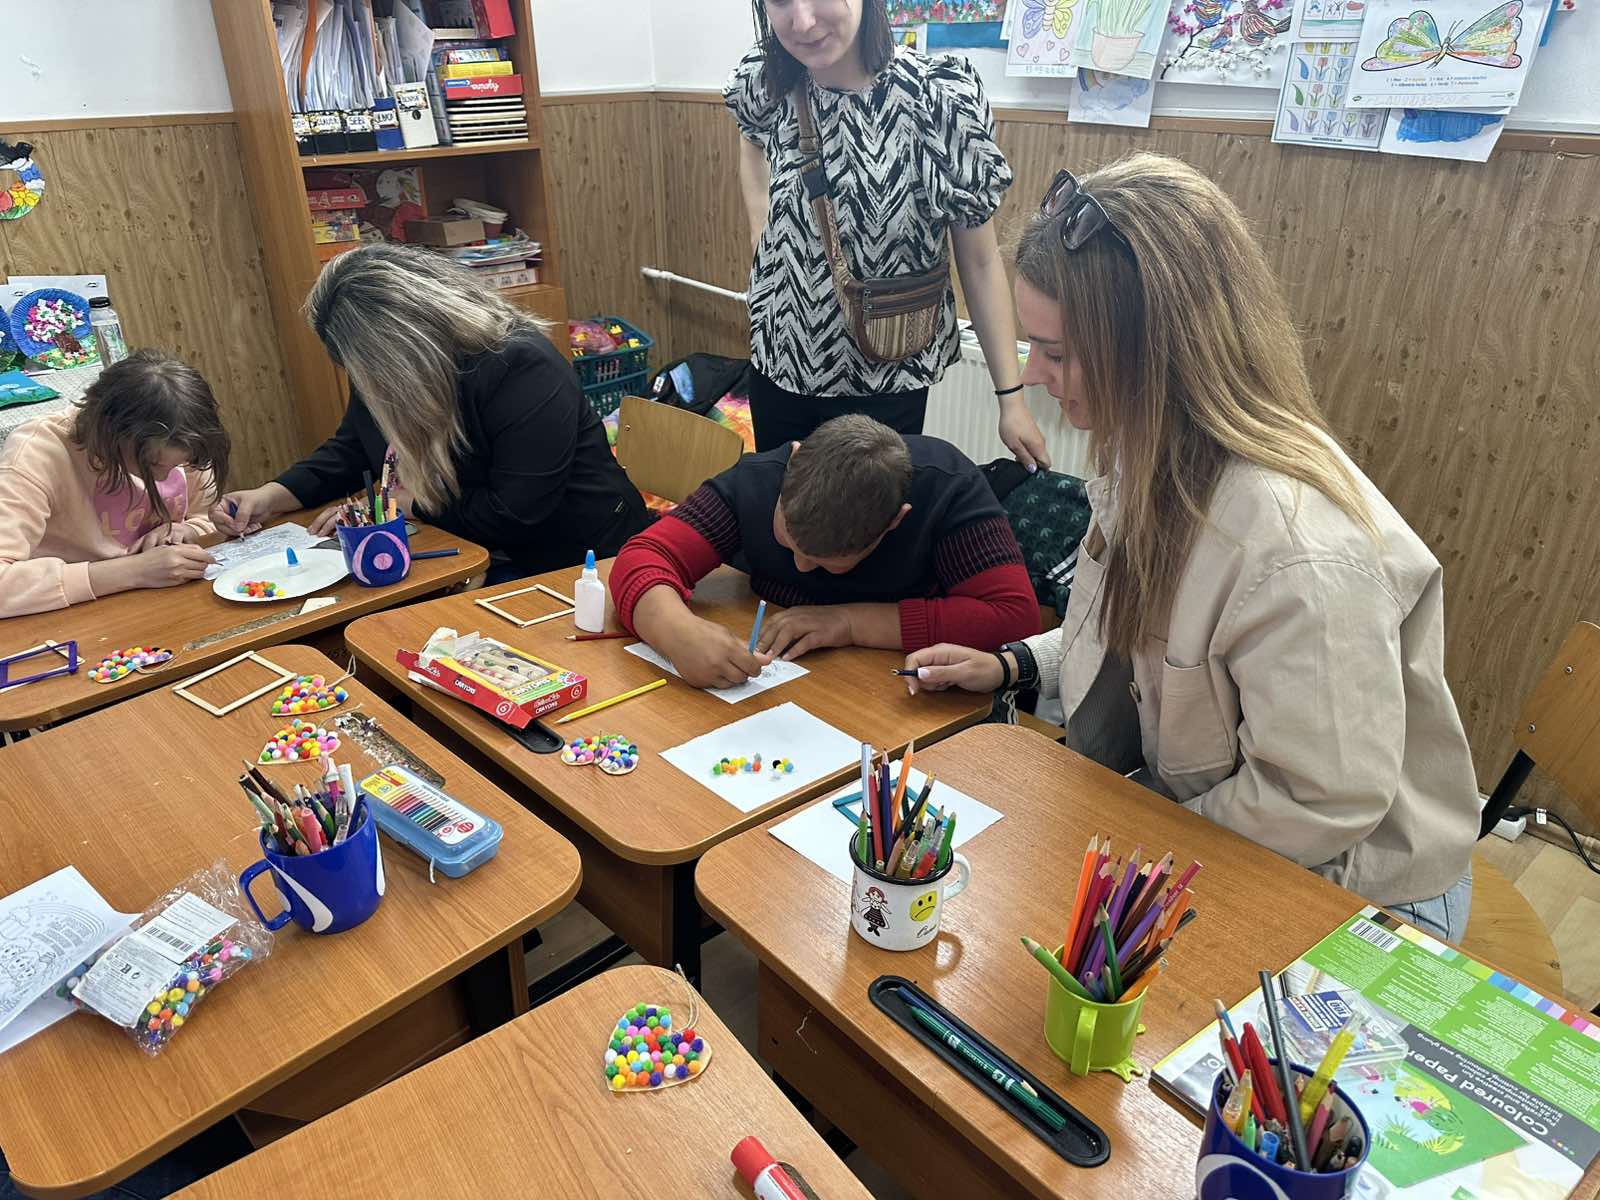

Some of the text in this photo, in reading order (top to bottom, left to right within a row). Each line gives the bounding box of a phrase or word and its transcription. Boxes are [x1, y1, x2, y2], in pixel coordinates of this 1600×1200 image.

[1329, 1001, 1348, 1016] 100
[1439, 1045, 1455, 1056] and
[1454, 1053, 1490, 1075] colouring
[1458, 1061, 1487, 1078] colours
[1407, 1049, 1549, 1136] Coloured Paper
[1475, 1076, 1504, 1096] creative
[1486, 1076, 1540, 1112] contemporary
[1503, 1093, 1521, 1105] and
[1530, 1096, 1564, 1118] Suitable
[1520, 1102, 1543, 1118] crafts
